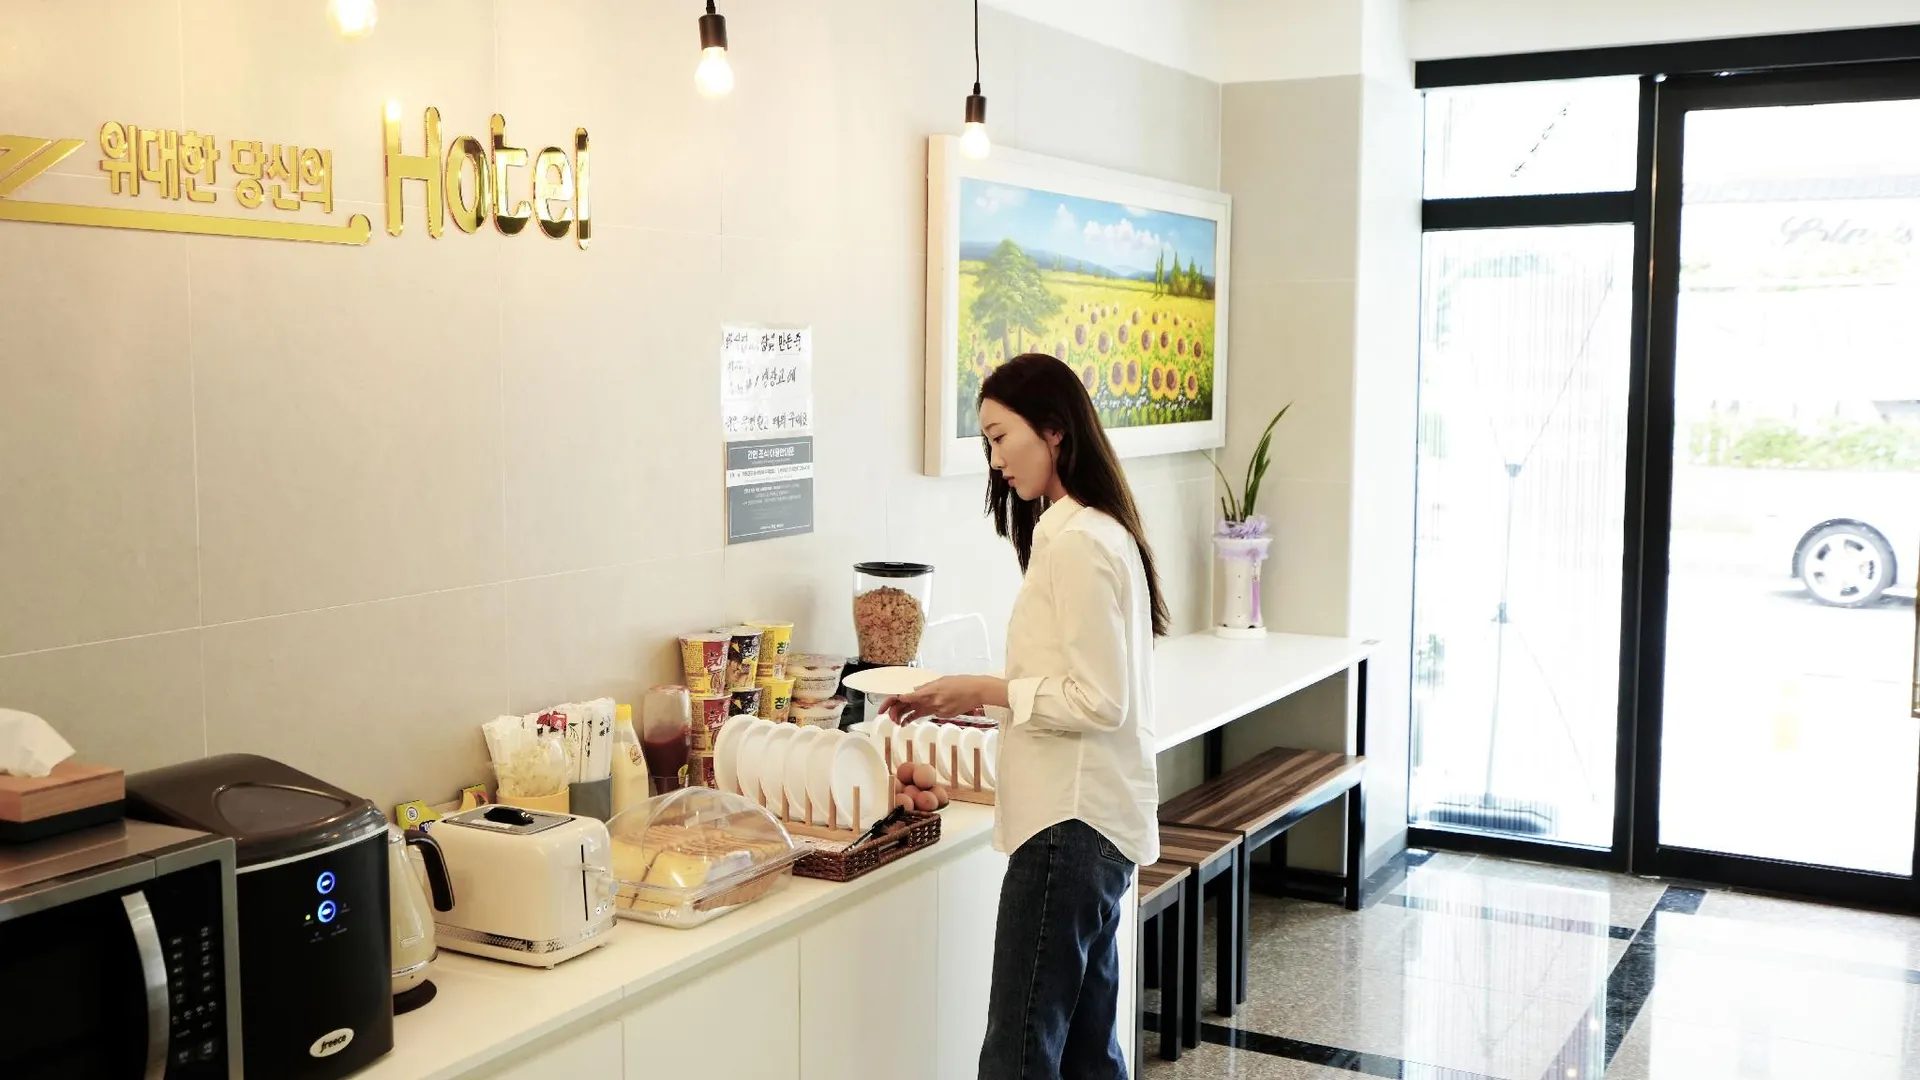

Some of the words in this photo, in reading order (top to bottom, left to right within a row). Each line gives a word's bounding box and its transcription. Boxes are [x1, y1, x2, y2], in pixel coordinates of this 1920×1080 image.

[98, 120, 221, 203] 위대한
[231, 139, 334, 213] 당신의
[383, 100, 592, 250] Hotel
[321, 1034, 347, 1053] freece
